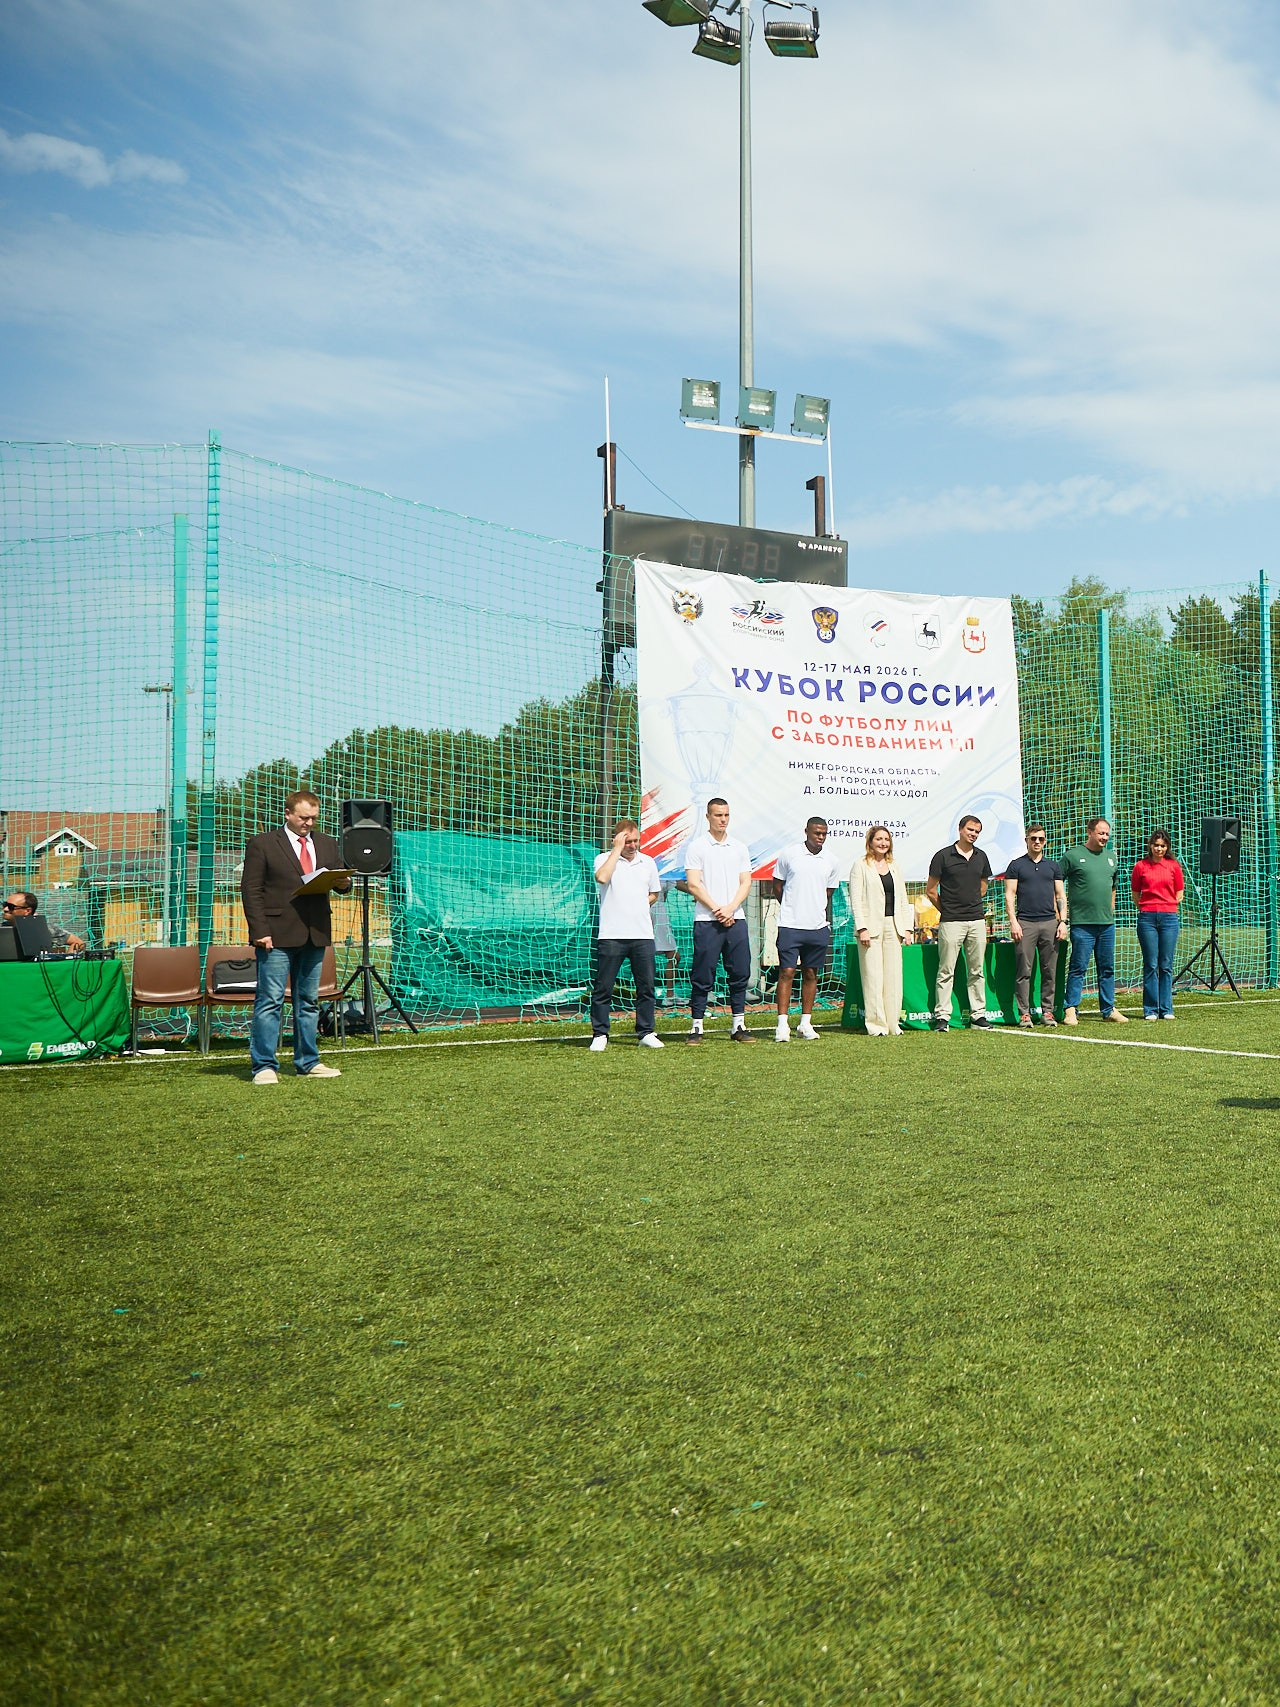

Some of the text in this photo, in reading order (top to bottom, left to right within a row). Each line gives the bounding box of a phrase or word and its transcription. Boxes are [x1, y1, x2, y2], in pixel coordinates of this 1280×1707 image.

[803, 662, 922, 677] 12-17 МАЯ 2026 Г.
[731, 667, 998, 707] КУБОК РОССИИ
[787, 709, 953, 734] ПО ФУТБОЛУ ЛИЦ
[771, 726, 785, 740] С
[792, 729, 943, 750] ЗАБОЛЕВАНИЕМ
[788, 761, 885, 775] НИЖЕГОРОДСКАЯ
[818, 774, 837, 783] Р-Н
[803, 785, 928, 798] Д. БОЛЬШОЙ СУХОДОЛ
[827, 818, 907, 828] ОРТИВНАЯ БАЗА
[826, 830, 865, 838] МЕРАЛЬ
